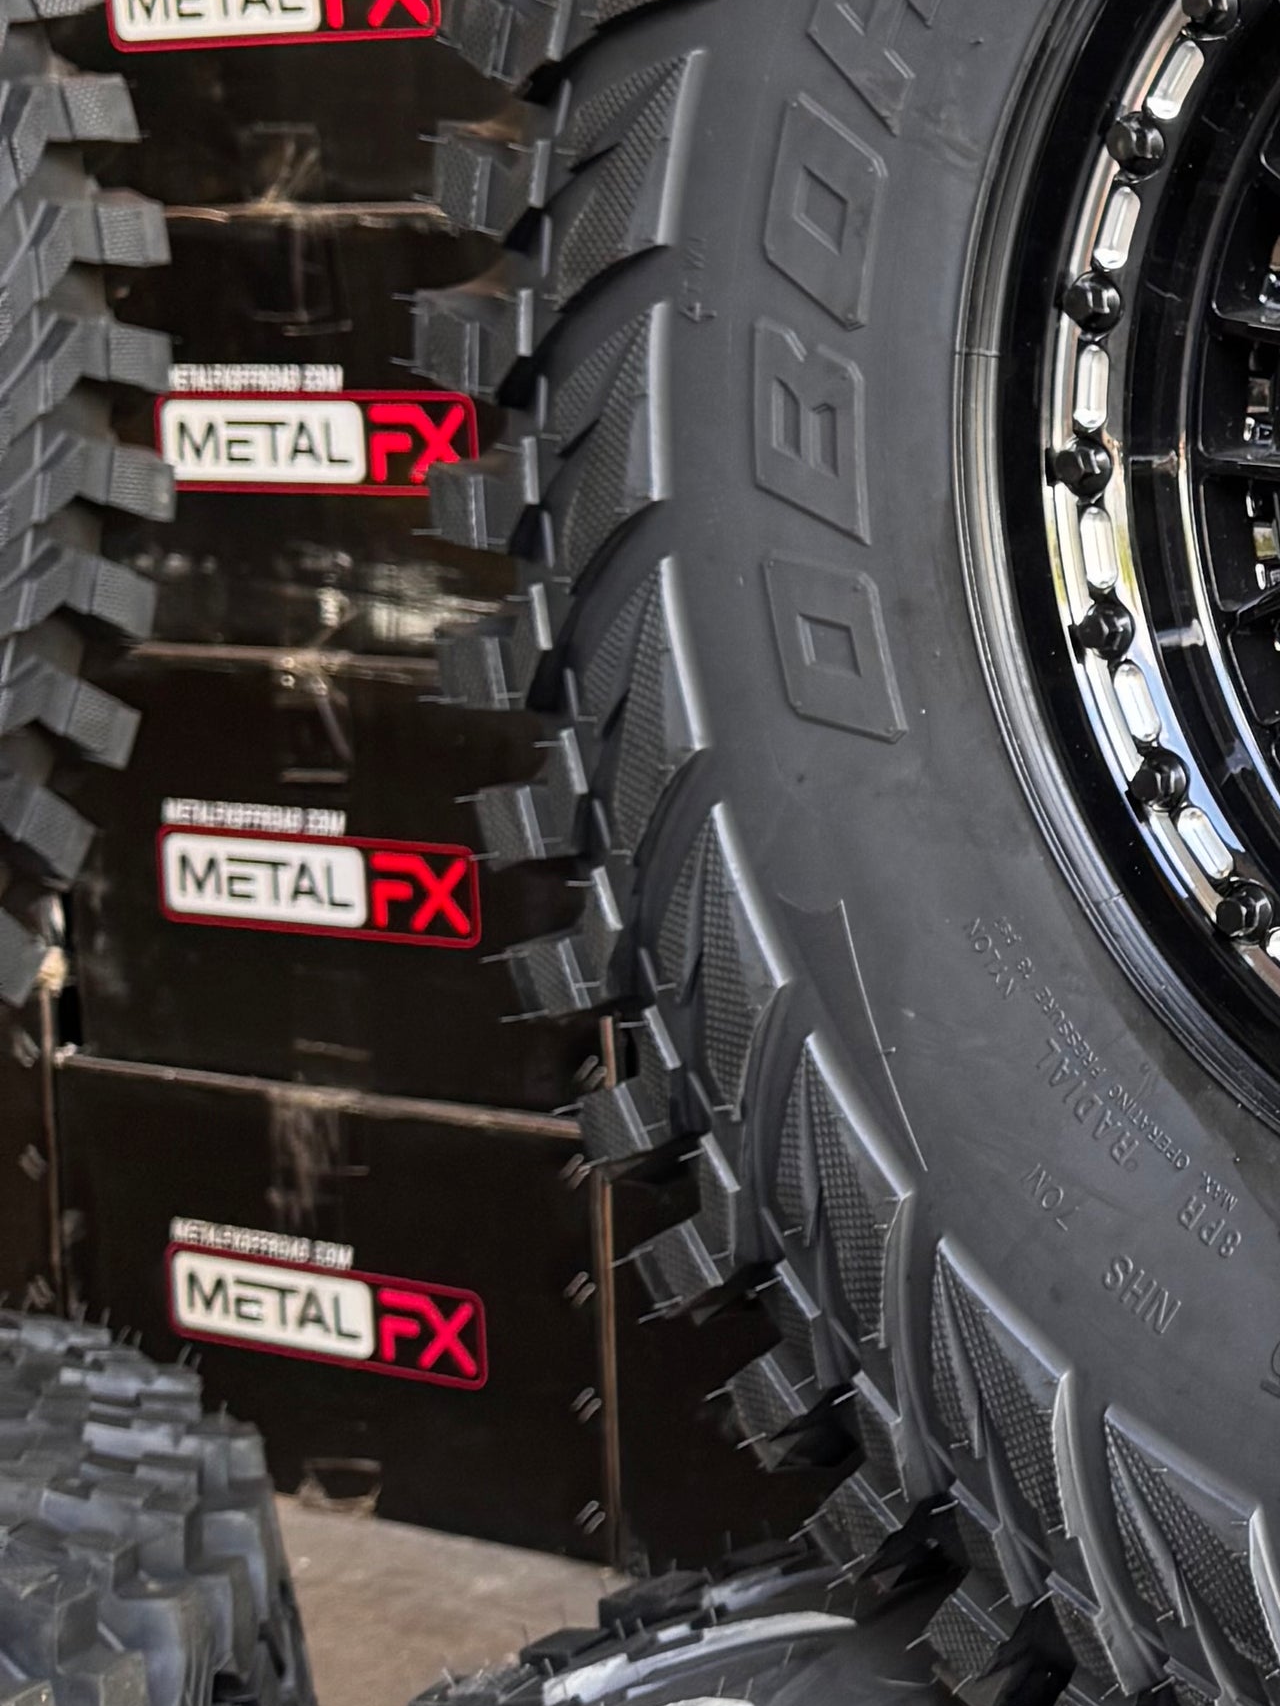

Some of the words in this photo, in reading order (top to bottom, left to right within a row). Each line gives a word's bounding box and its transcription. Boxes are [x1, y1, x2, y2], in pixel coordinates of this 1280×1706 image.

[178, 420, 350, 463] METAL
[368, 402, 465, 484] FX
[178, 853, 353, 907] METAL
[369, 851, 471, 935] FX
[1034, 985, 1108, 1079] PRESSURE
[1036, 1036, 1140, 1167] RADIAL
[1108, 1083, 1191, 1171] OPERATING
[1178, 1194, 1242, 1259] 8PR
[186, 1269, 362, 1340] METAL
[376, 1286, 478, 1379] FX
[1103, 1254, 1182, 1334] NHS
